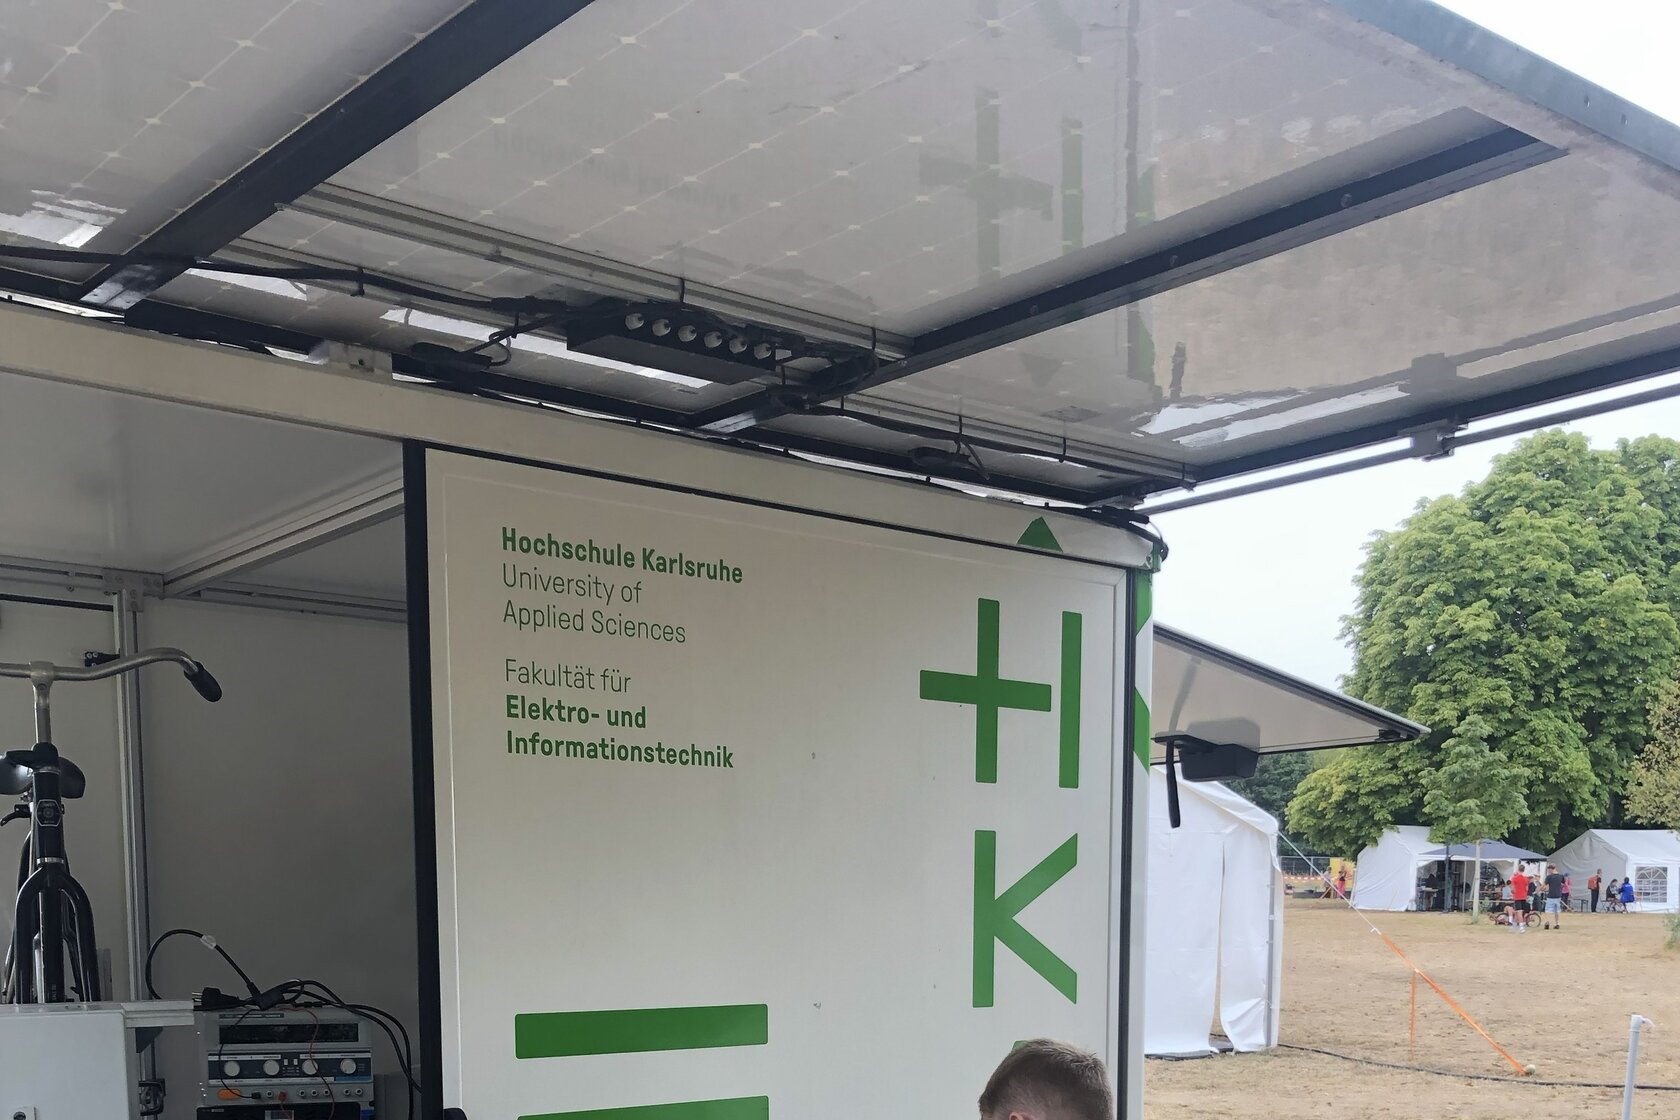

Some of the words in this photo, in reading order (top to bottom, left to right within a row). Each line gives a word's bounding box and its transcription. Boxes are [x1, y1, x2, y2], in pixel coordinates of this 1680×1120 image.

[502, 526, 635, 569] Hochschule
[642, 547, 743, 584] Karlsruhe
[502, 563, 614, 606] University
[621, 581, 642, 603] of
[503, 600, 584, 633] Applied
[591, 610, 686, 643] Sciences
[505, 658, 595, 690] Fakultät
[600, 668, 631, 693] für
[506, 694, 600, 724] Elektro-
[606, 706, 646, 729] und
[507, 730, 734, 768] Informationstechnik
